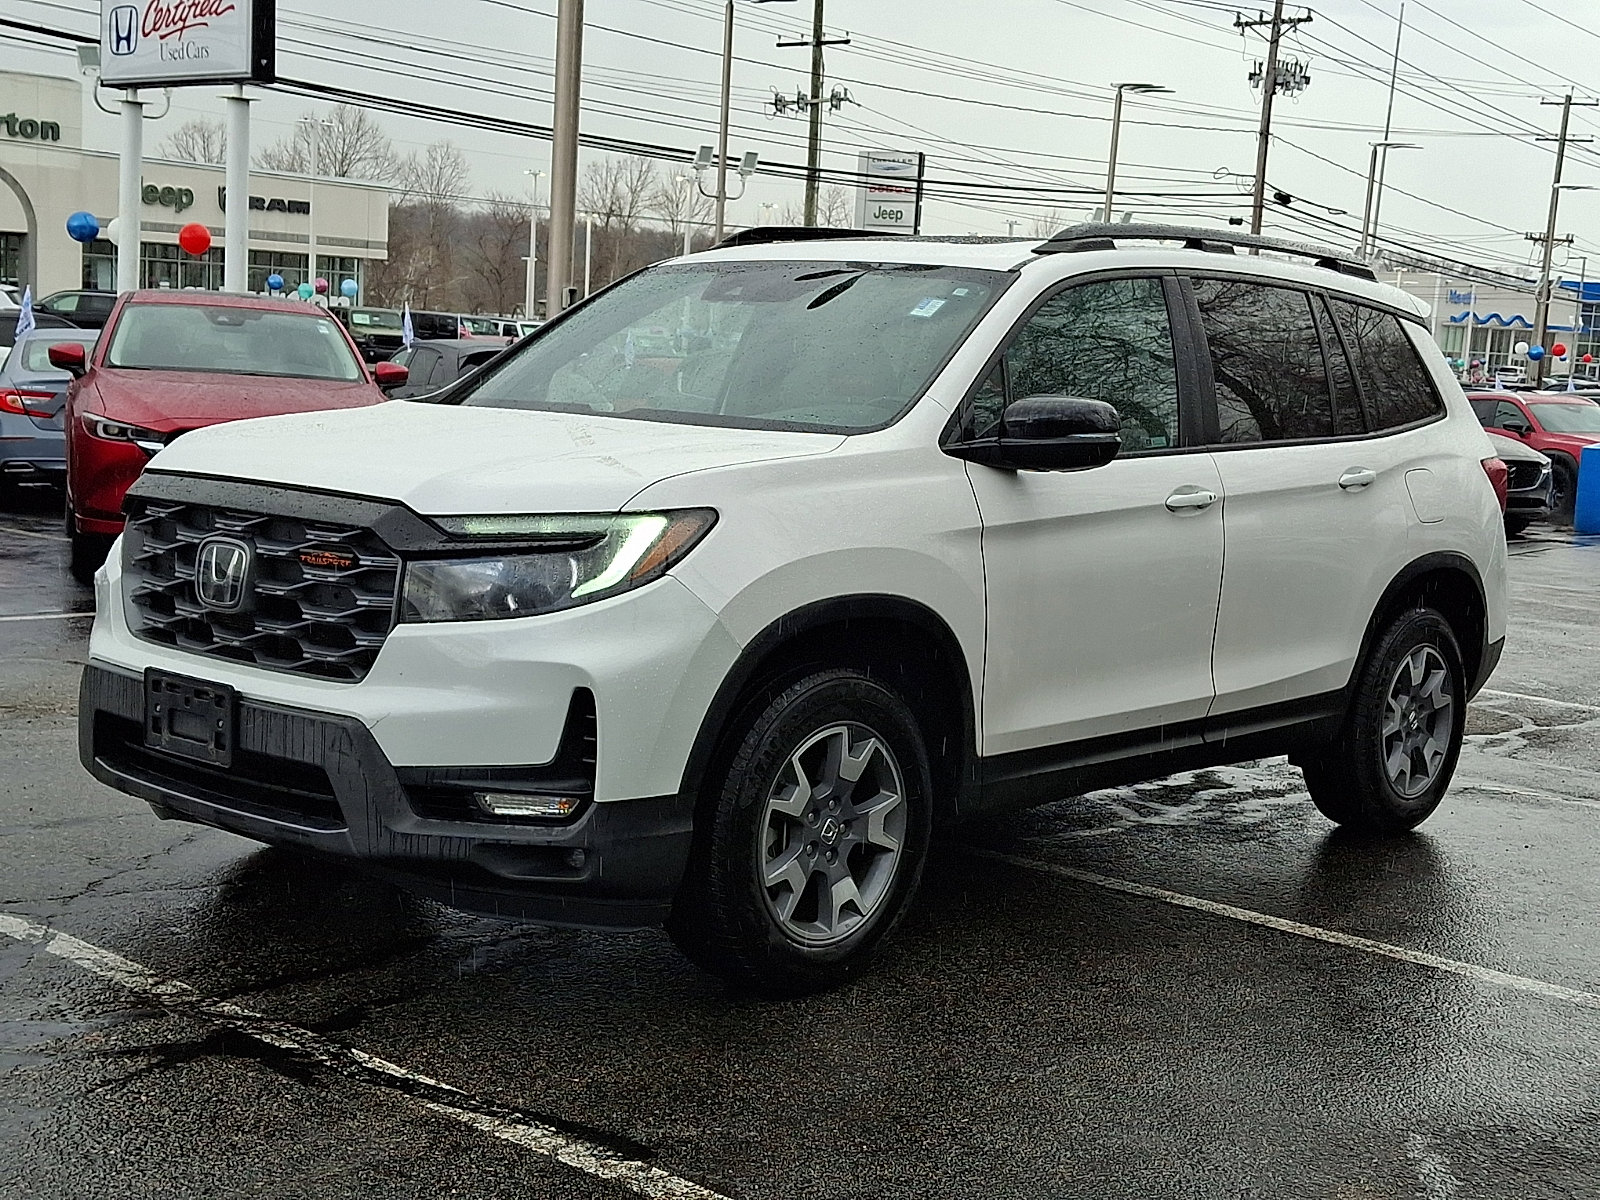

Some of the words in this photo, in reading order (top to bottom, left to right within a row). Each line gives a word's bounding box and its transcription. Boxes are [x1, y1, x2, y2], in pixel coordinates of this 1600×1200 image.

[159, 42, 184, 61] Used
[185, 40, 209, 60] Cars
[140, 175, 194, 213] eep
[248, 195, 311, 215] RAM
[873, 205, 904, 223] Jeep
